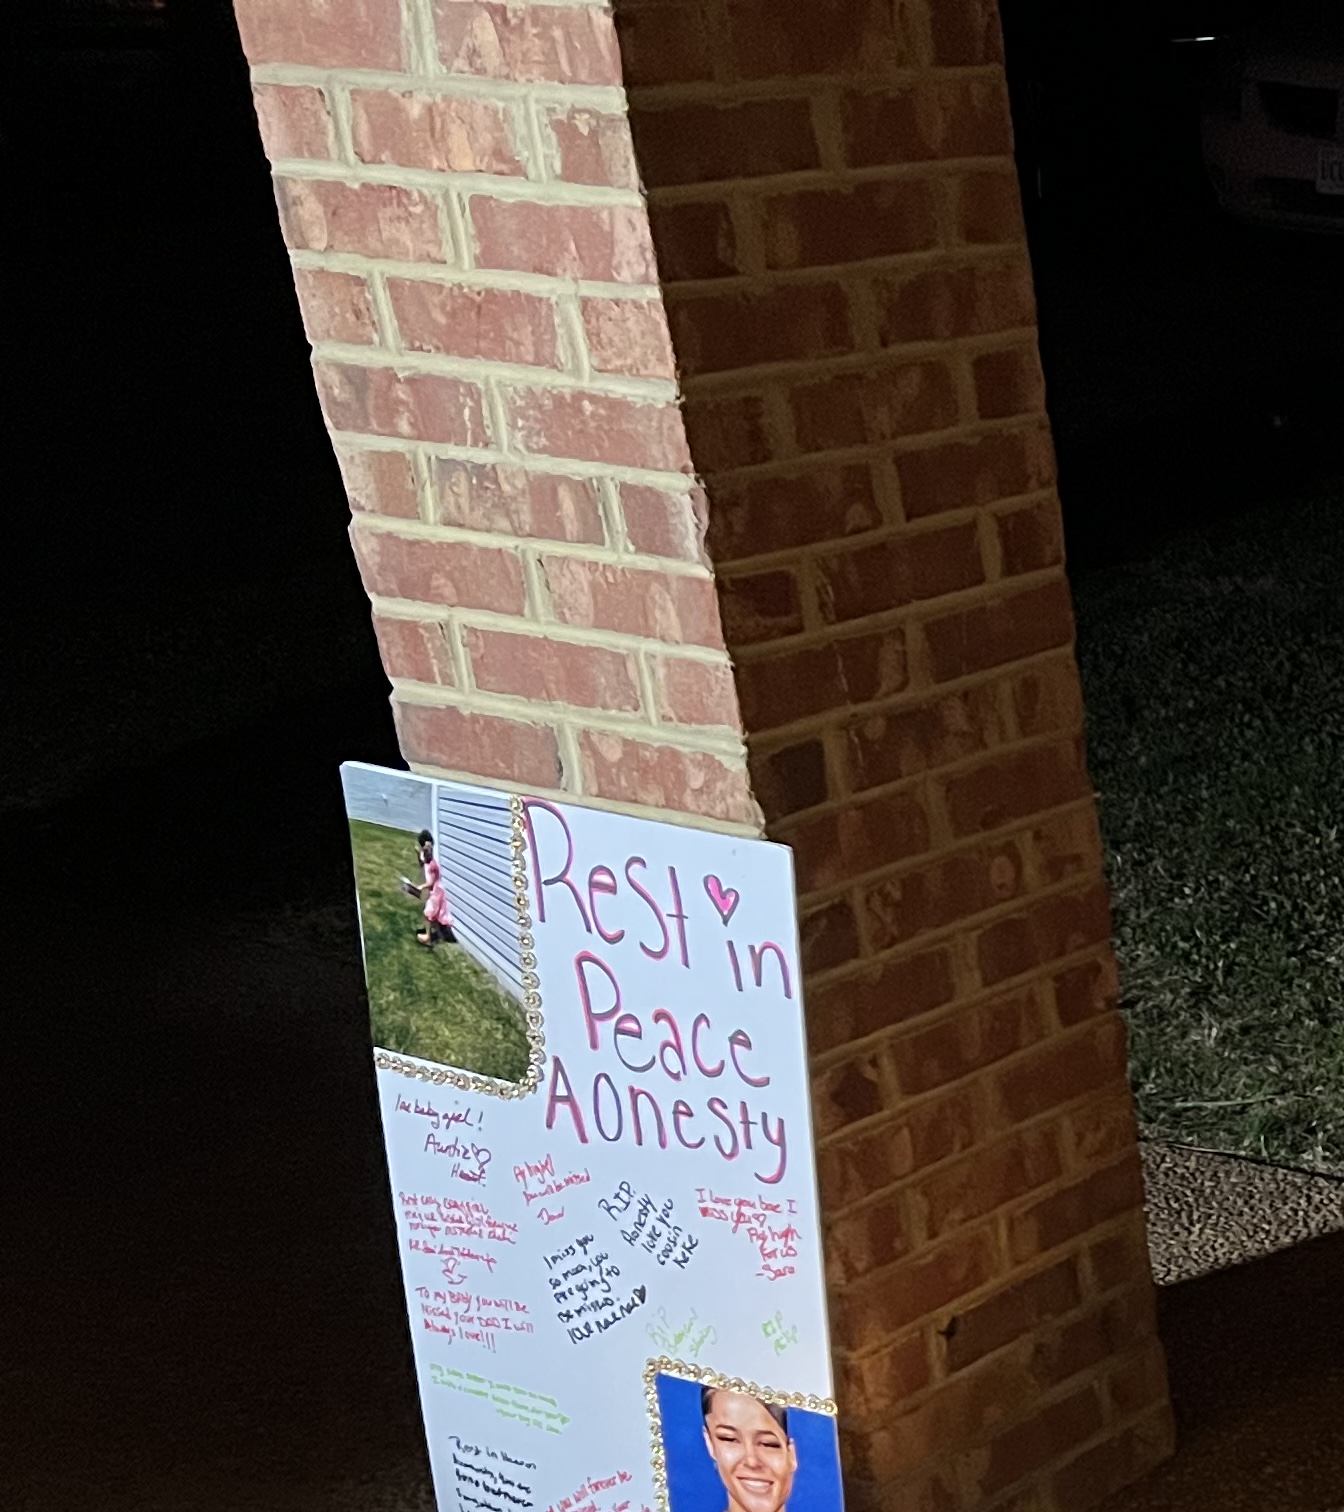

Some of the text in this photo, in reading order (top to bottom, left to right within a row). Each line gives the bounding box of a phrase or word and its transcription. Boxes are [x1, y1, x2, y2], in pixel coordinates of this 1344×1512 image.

[523, 797, 792, 999] Rest in
[573, 950, 771, 1087] Peace
[545, 1055, 787, 1184] Aonesty
